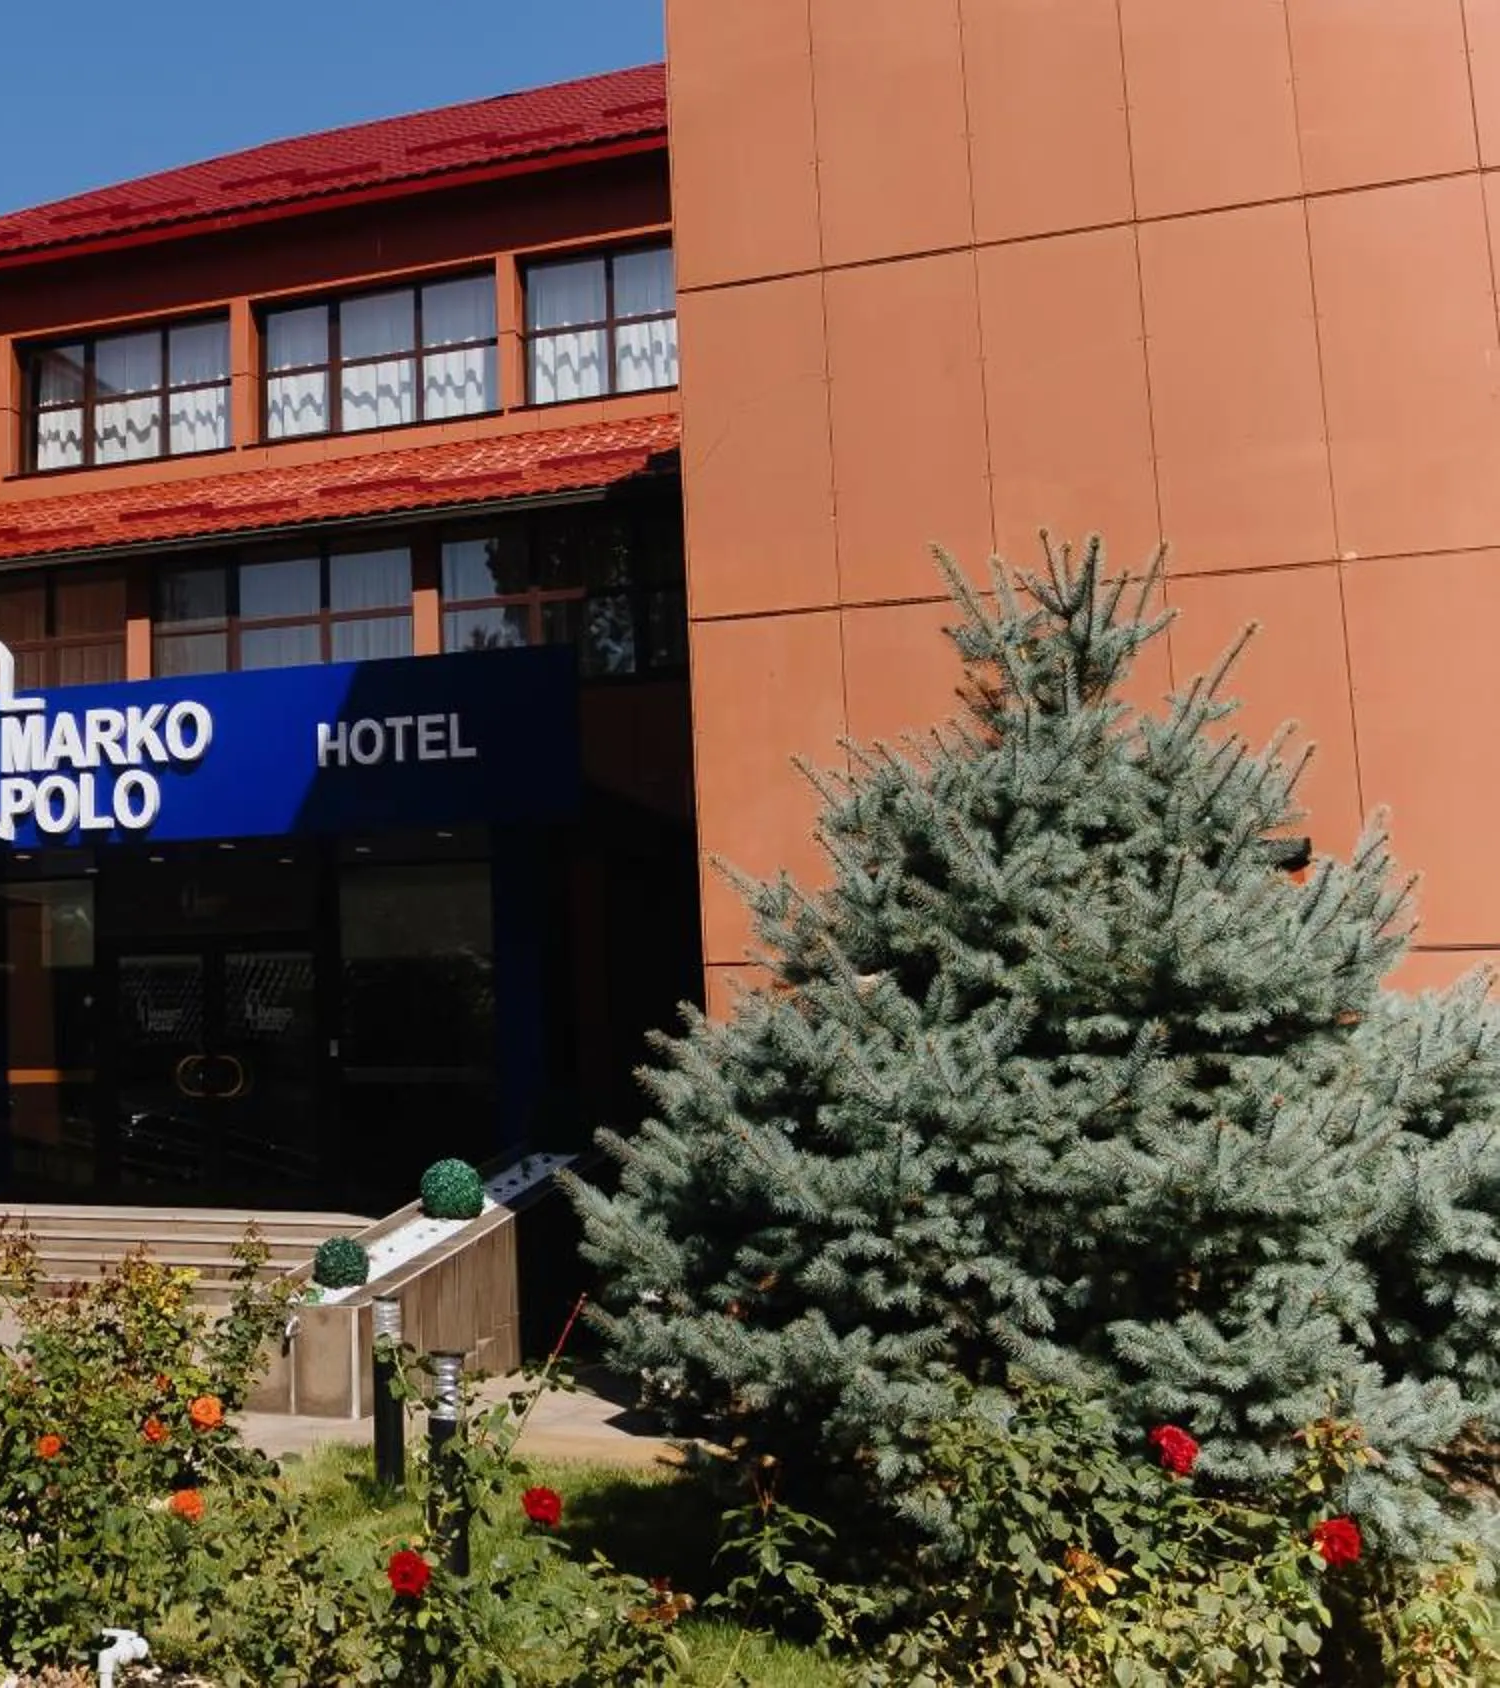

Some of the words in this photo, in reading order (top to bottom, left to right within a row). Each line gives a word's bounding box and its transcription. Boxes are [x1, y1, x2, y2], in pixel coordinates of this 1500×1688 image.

[0, 700, 212, 773] MARKO
[317, 712, 477, 767] HOTEL
[0, 769, 160, 834] POLO
